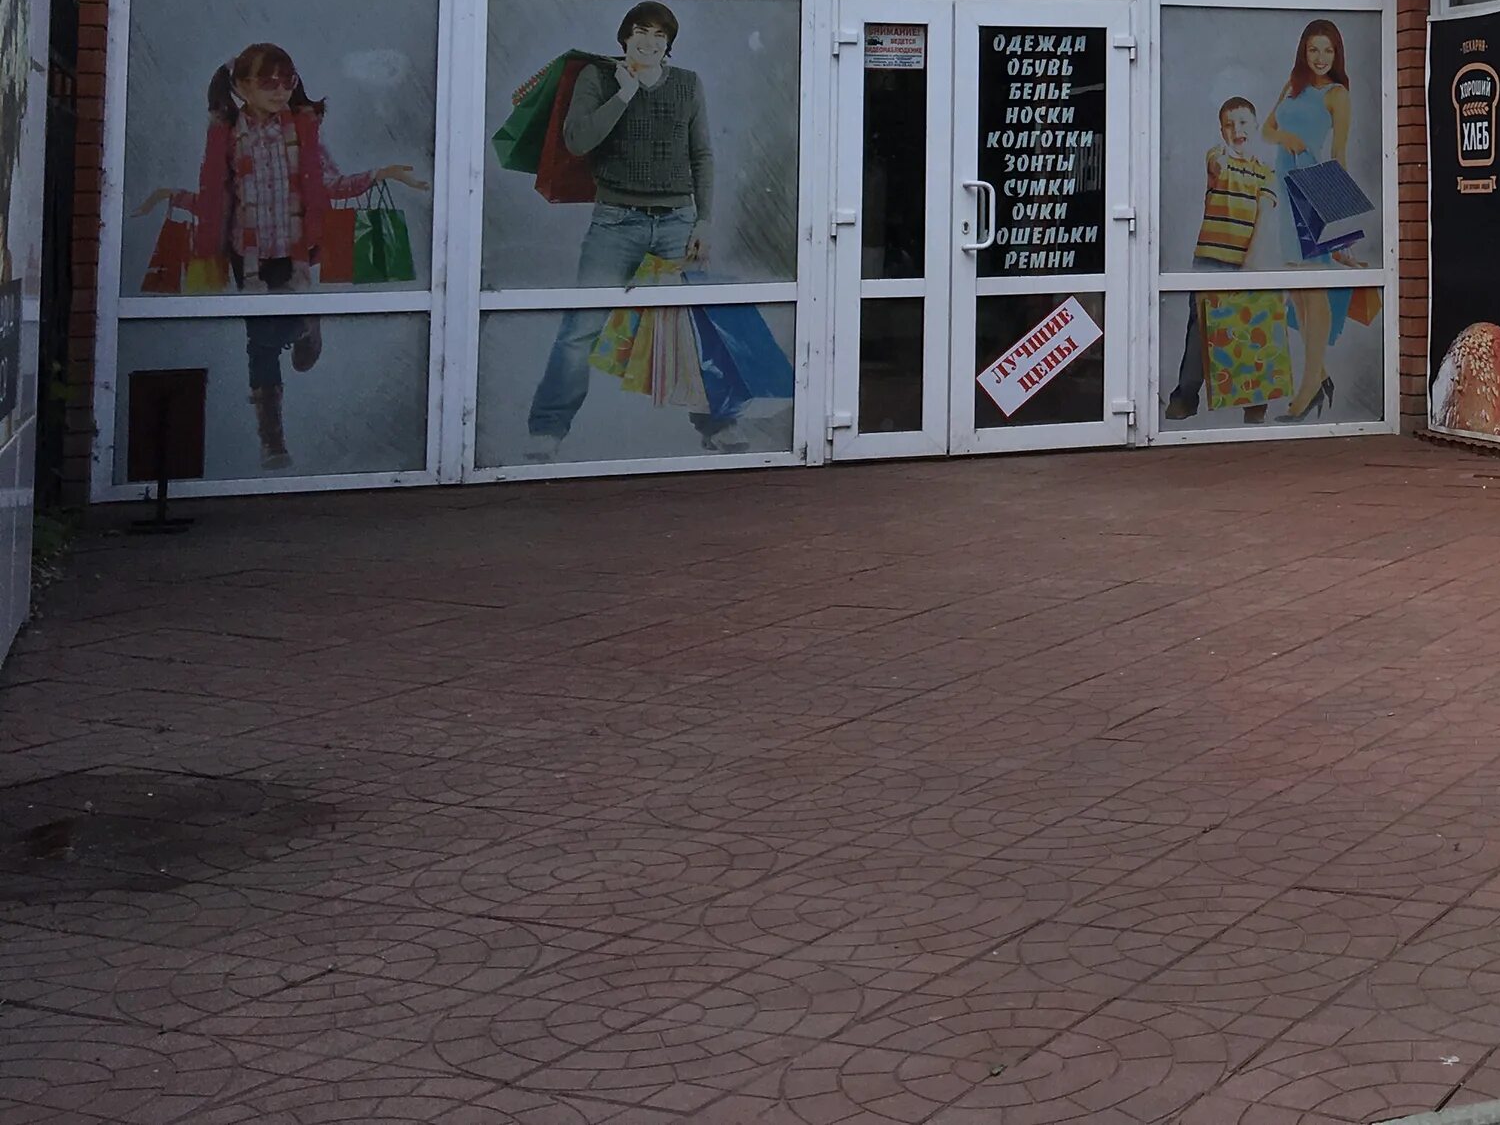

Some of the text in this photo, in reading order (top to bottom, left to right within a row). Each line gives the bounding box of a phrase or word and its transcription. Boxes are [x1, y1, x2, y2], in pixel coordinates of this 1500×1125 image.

[993, 33, 1087, 55] ОДЕЖДА
[1007, 58, 1073, 78] ОБУВЬ
[1009, 82, 1072, 101] БЕЛЬЕ
[1460, 76, 1491, 100] ХОРОШИЙ
[1005, 106, 1075, 124] НОСКИ
[986, 130, 1094, 149] КОЛГОТКИ
[1462, 121, 1490, 151] ХЛЕБ
[1003, 153, 1075, 172] ЗОНТЫ
[1003, 178, 1076, 198] СУМКИ
[1012, 202, 1068, 220] ОЧКИ
[990, 225, 1099, 246] ОШЕЛЬКИ
[1004, 250, 1076, 269] РЕМНИ
[991, 307, 1074, 384] ЛУЧШИЕ
[1017, 336, 1079, 393] ЦЕНЫ
